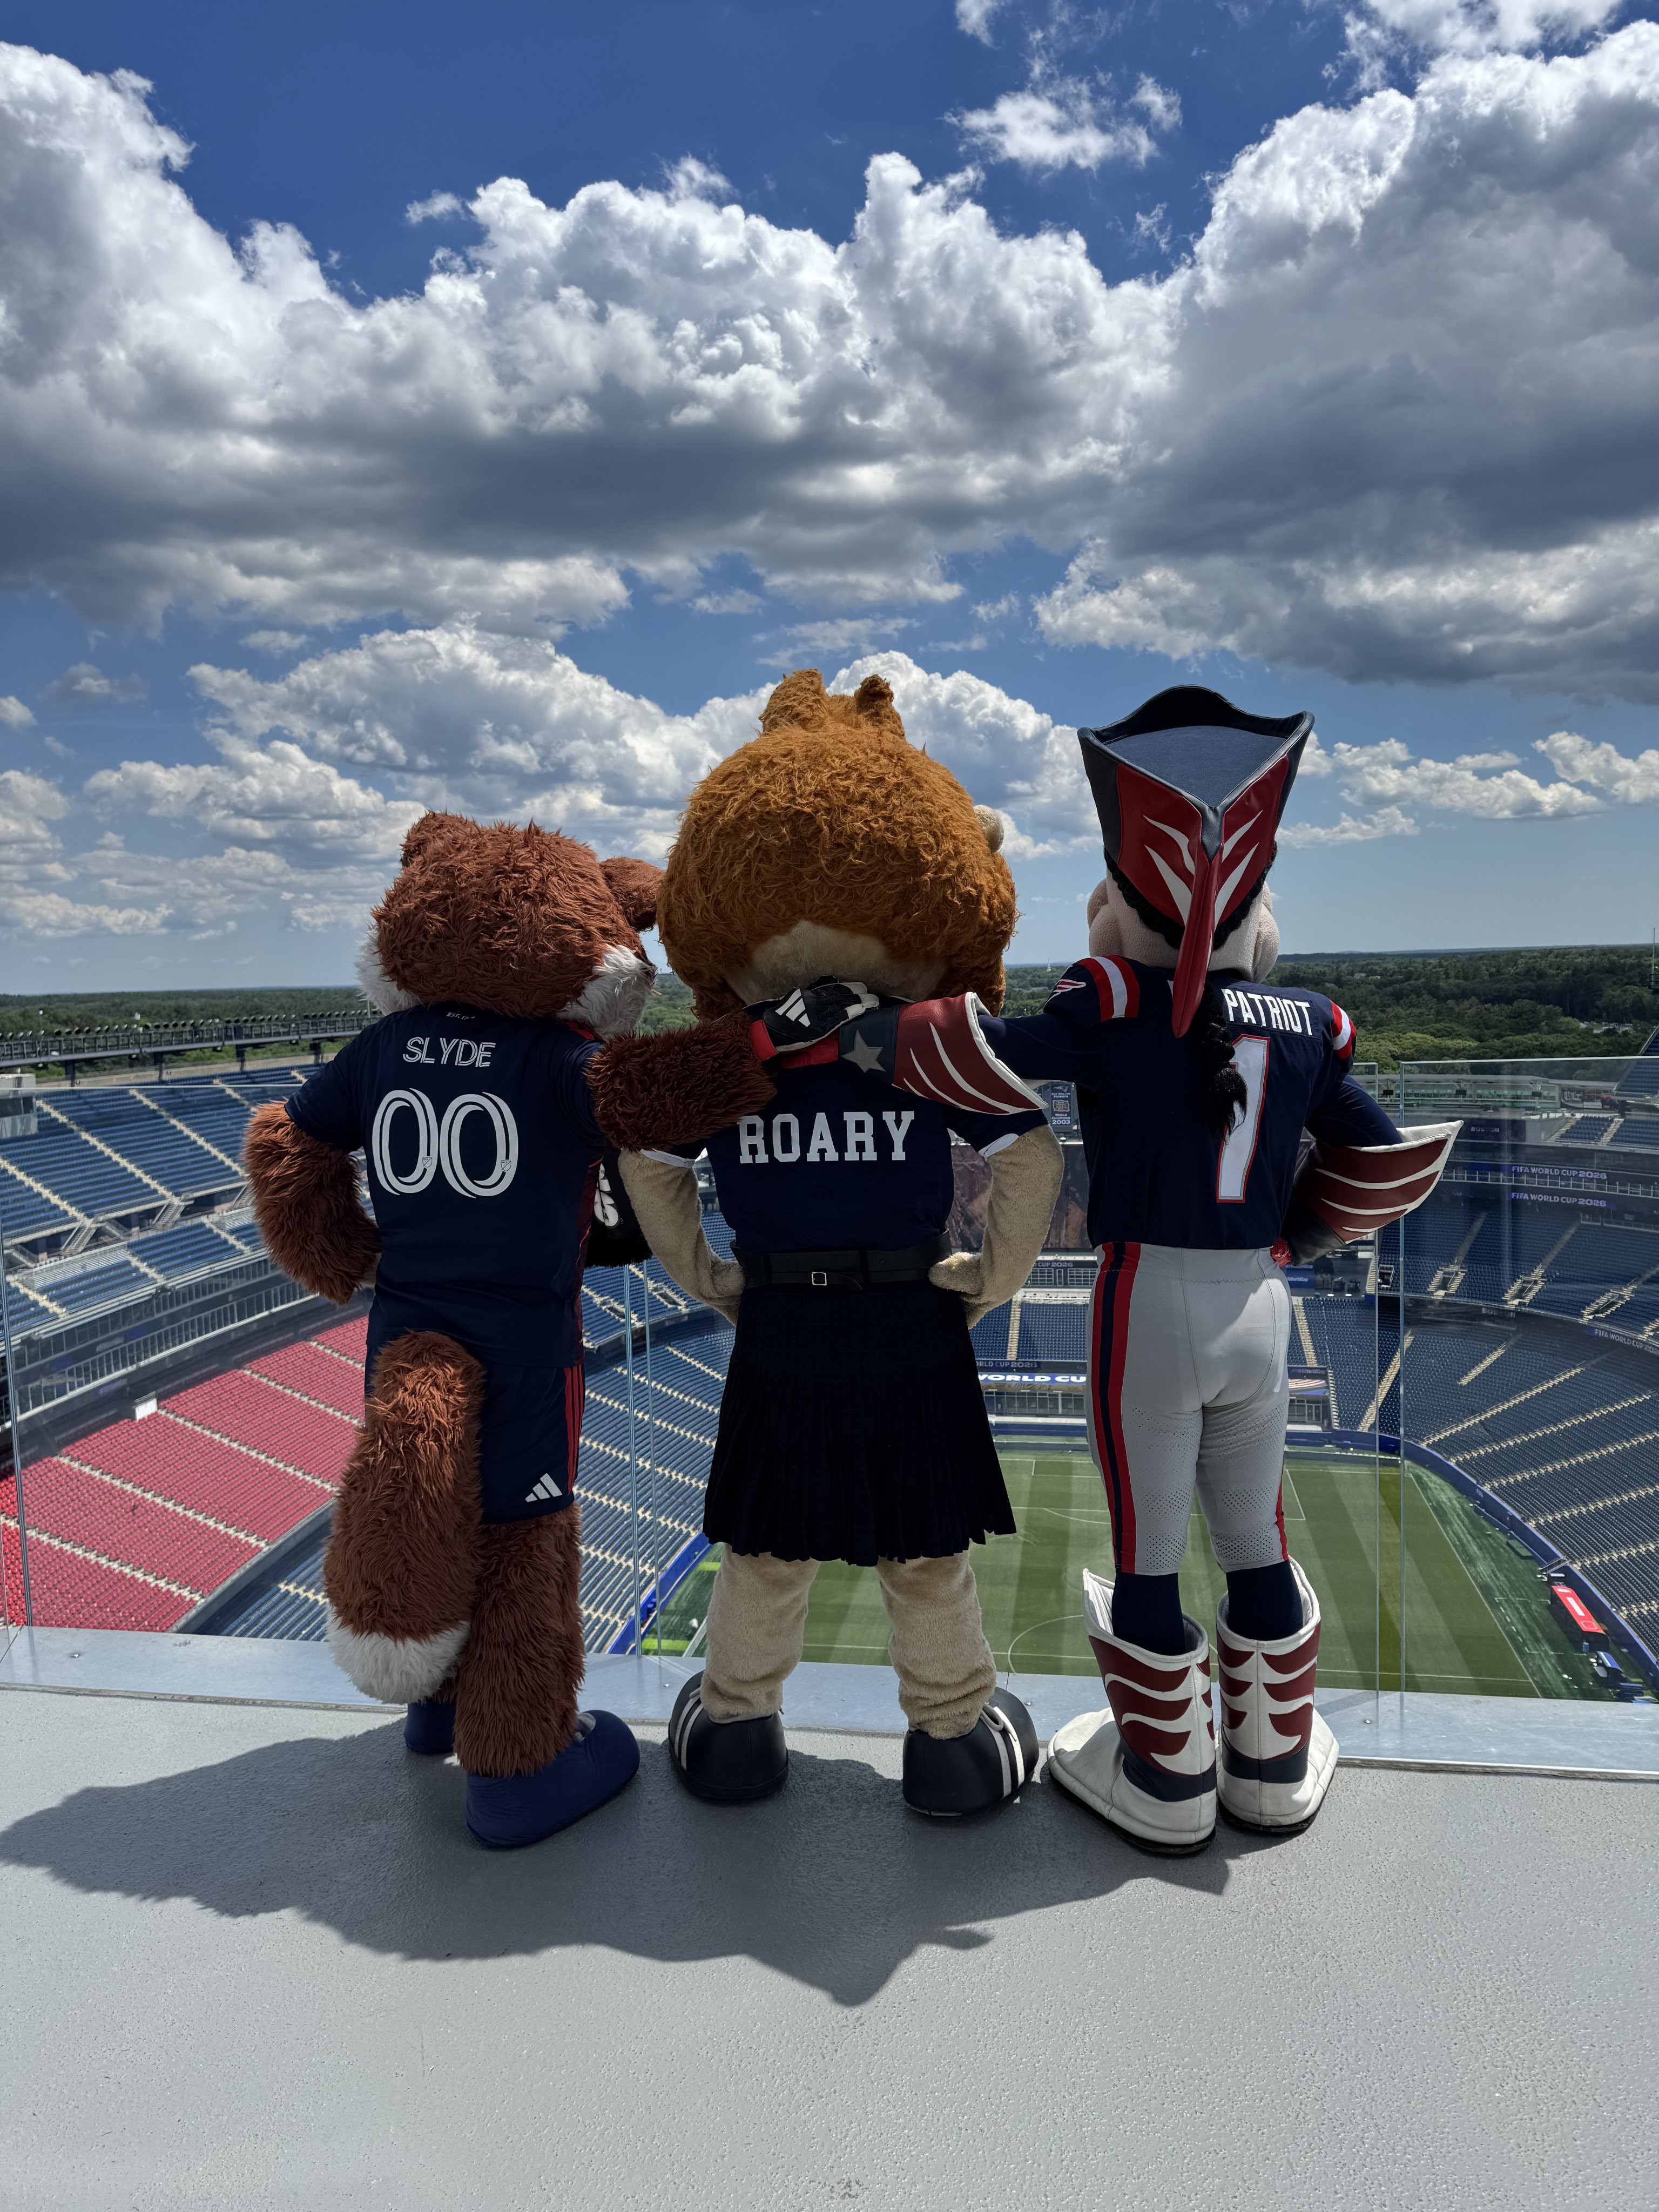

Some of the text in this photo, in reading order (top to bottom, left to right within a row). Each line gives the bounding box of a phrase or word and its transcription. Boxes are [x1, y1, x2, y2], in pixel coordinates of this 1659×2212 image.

[1221, 988, 1313, 1036] PATRIOT
[402, 1036, 496, 1068] SLYDE
[1216, 1034, 1270, 1203] 1
[372, 1088, 518, 1199] 00
[737, 1111, 914, 1164] ROARY
[1530, 1167, 1560, 1175] WORLD
[1579, 1170, 1607, 1179] 2026
[1530, 1194, 1559, 1203] WORLD
[1561, 1196, 1577, 1204] CUP
[1578, 1198, 1607, 1207] 2026
[1482, 1307, 1516, 1317] BOSON
[1595, 1328, 1608, 1338] FIFA
[1609, 1333, 1631, 1345] WORLD
[1633, 1340, 1644, 1348] CUP
